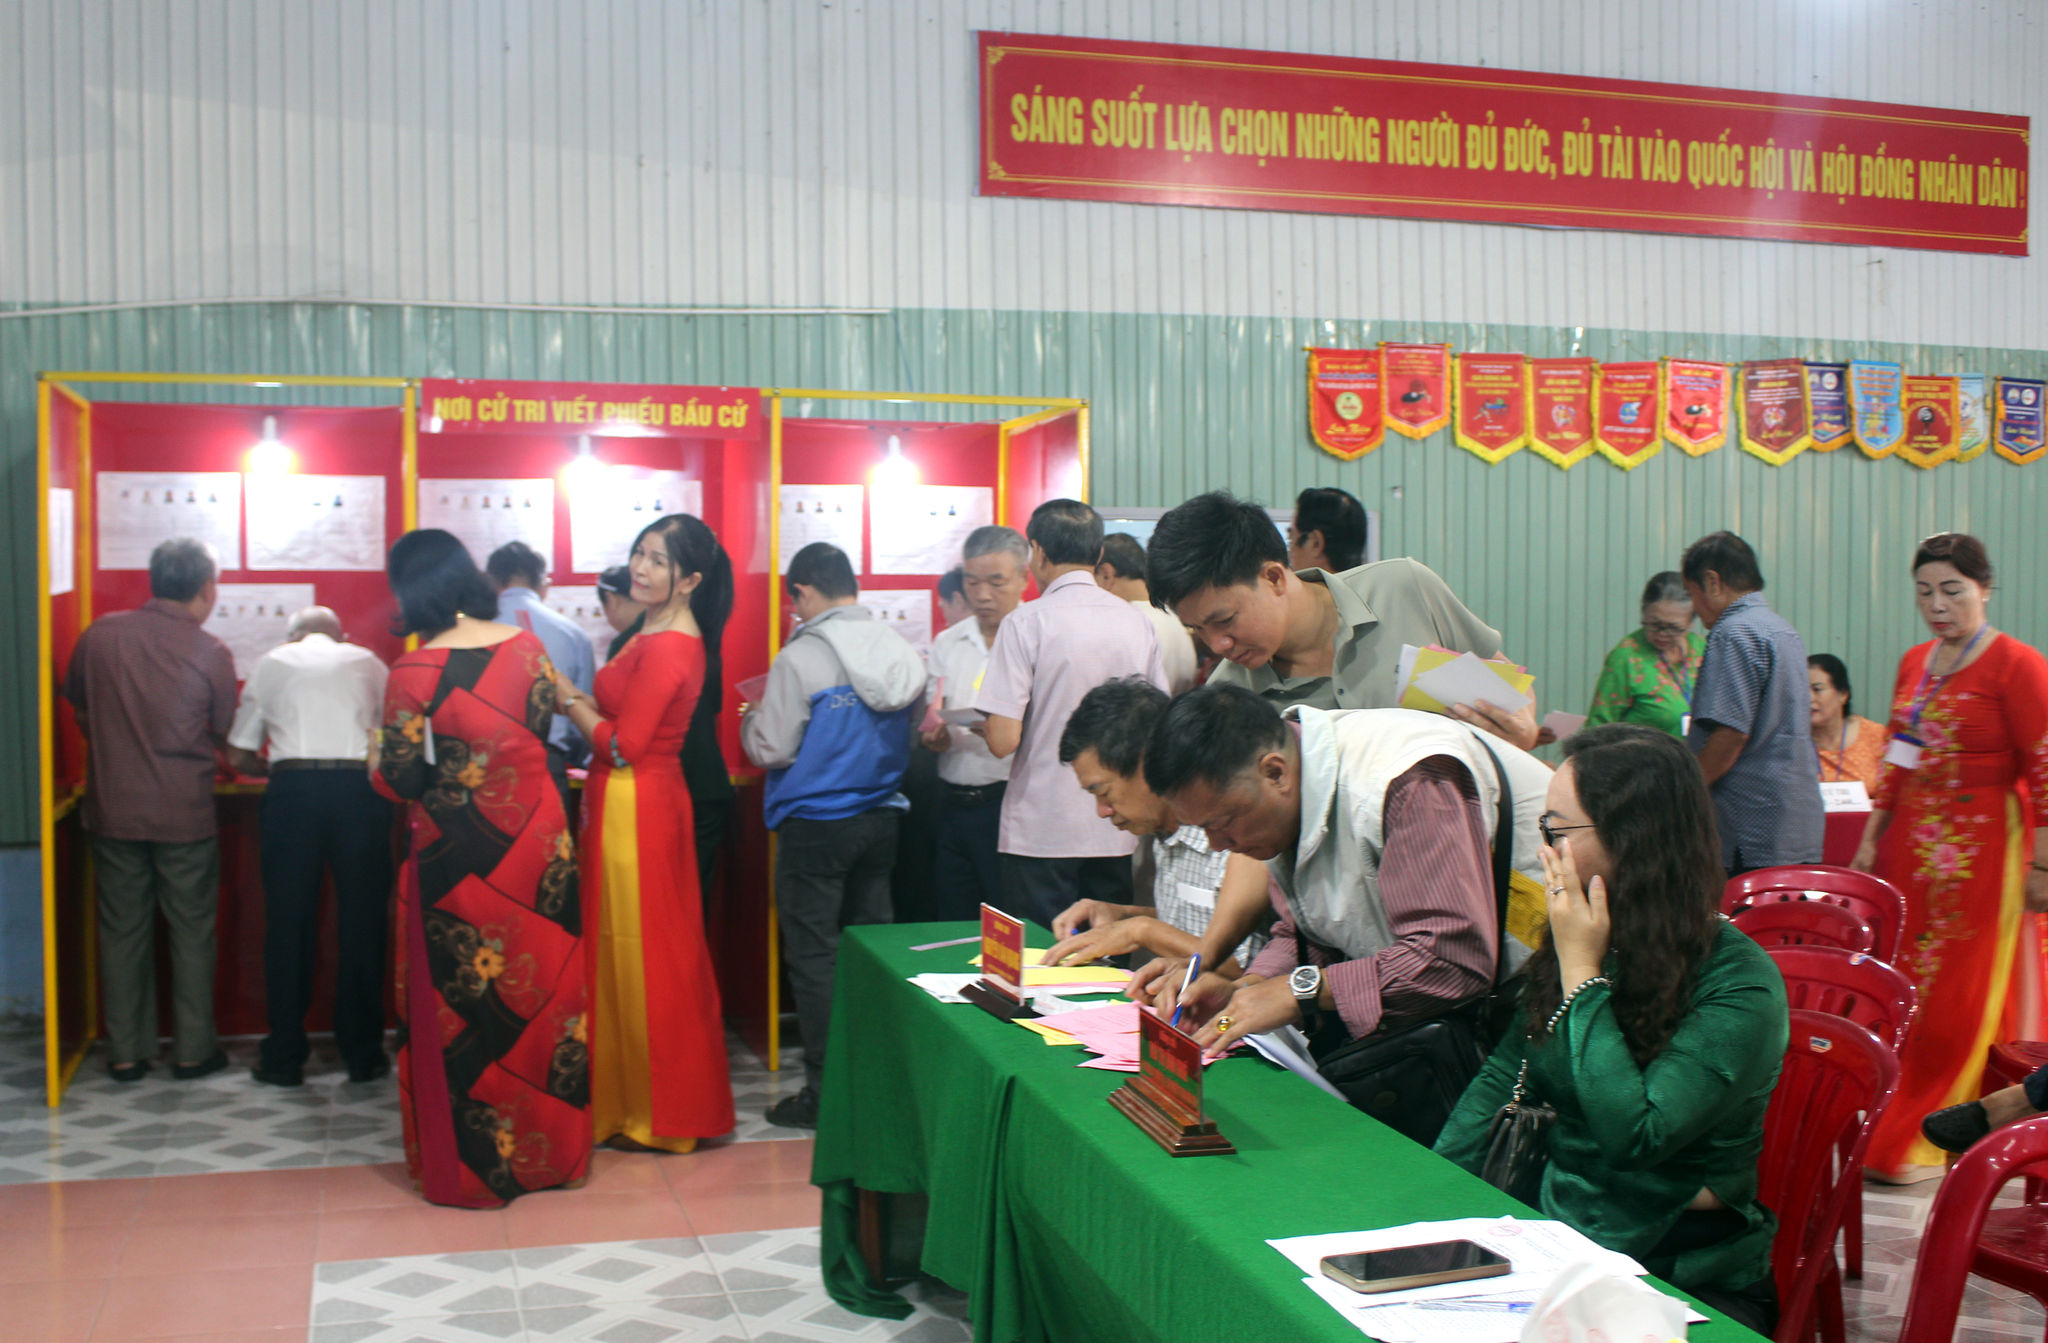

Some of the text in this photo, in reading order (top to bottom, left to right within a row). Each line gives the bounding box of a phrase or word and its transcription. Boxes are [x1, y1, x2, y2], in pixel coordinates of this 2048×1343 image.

[1011, 84, 1084, 145] SÁNG
[1091, 84, 1158, 149] SUỐT
[1164, 101, 1213, 162] LỰA
[1220, 107, 1289, 167] CHỌN
[1296, 106, 1381, 164] NHỮNG
[1387, 110, 1460, 169] NGƯỜI
[1466, 110, 1498, 171] ĐỦ
[1503, 117, 1557, 180] ĐỨC,
[1562, 117, 1594, 177] ĐỦ
[1598, 125, 1634, 179] TÀI
[1639, 128, 1682, 183] VÀO
[1687, 127, 1745, 190] QUỐC
[1749, 138, 1784, 199] HỘI
[1790, 140, 1817, 193] VÀ
[1821, 143, 1856, 205] HỘI
[1919, 153, 1974, 205] NHÂN
[434, 395, 472, 422] NƠI
[477, 391, 510, 422] CỬ
[512, 398, 546, 423] TRI
[551, 394, 598, 424] VIẾT
[603, 396, 666, 426] PHIẾU
[717, 398, 750, 428] CỬ
